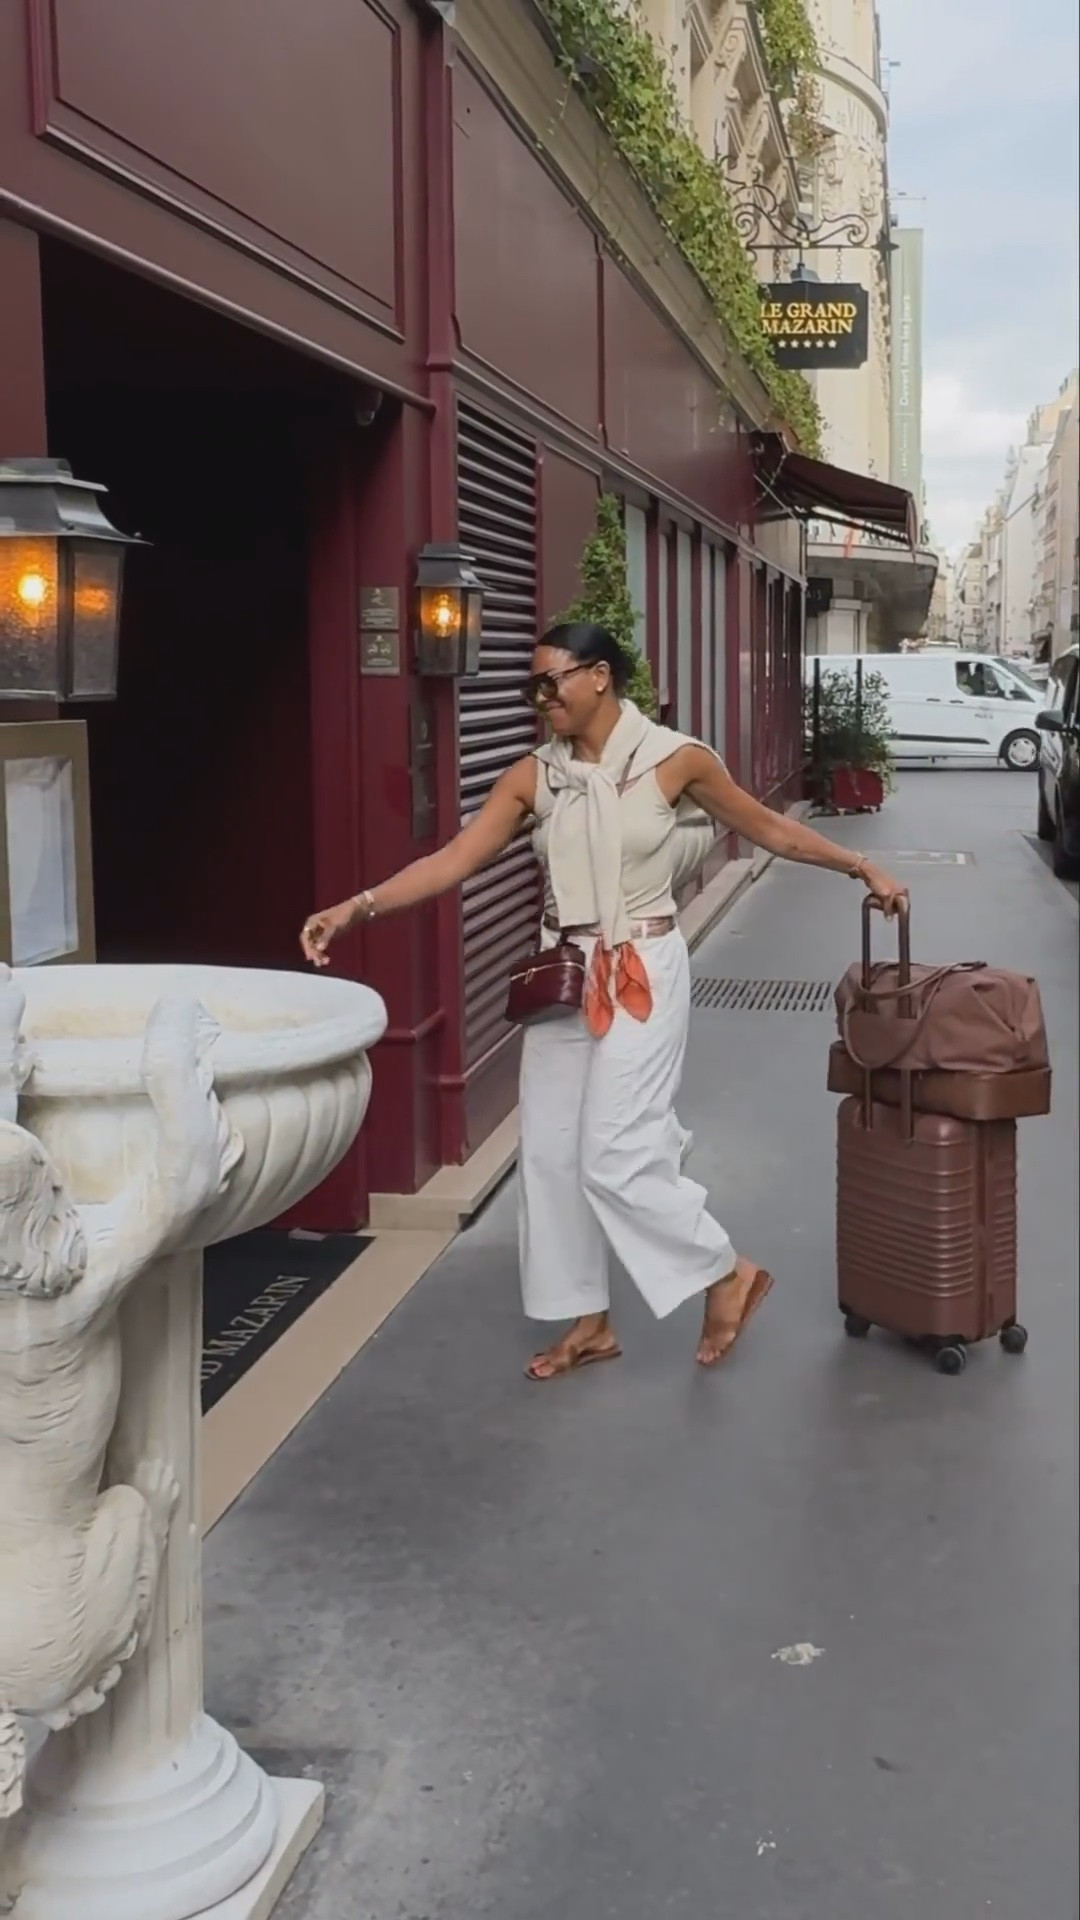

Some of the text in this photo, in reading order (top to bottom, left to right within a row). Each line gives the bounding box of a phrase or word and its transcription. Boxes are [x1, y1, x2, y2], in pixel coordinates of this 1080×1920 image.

[761, 302, 857, 318] LE GRAND
[761, 319, 854, 334] MAZARIN
[203, 1275, 310, 1356] MAZARIN
